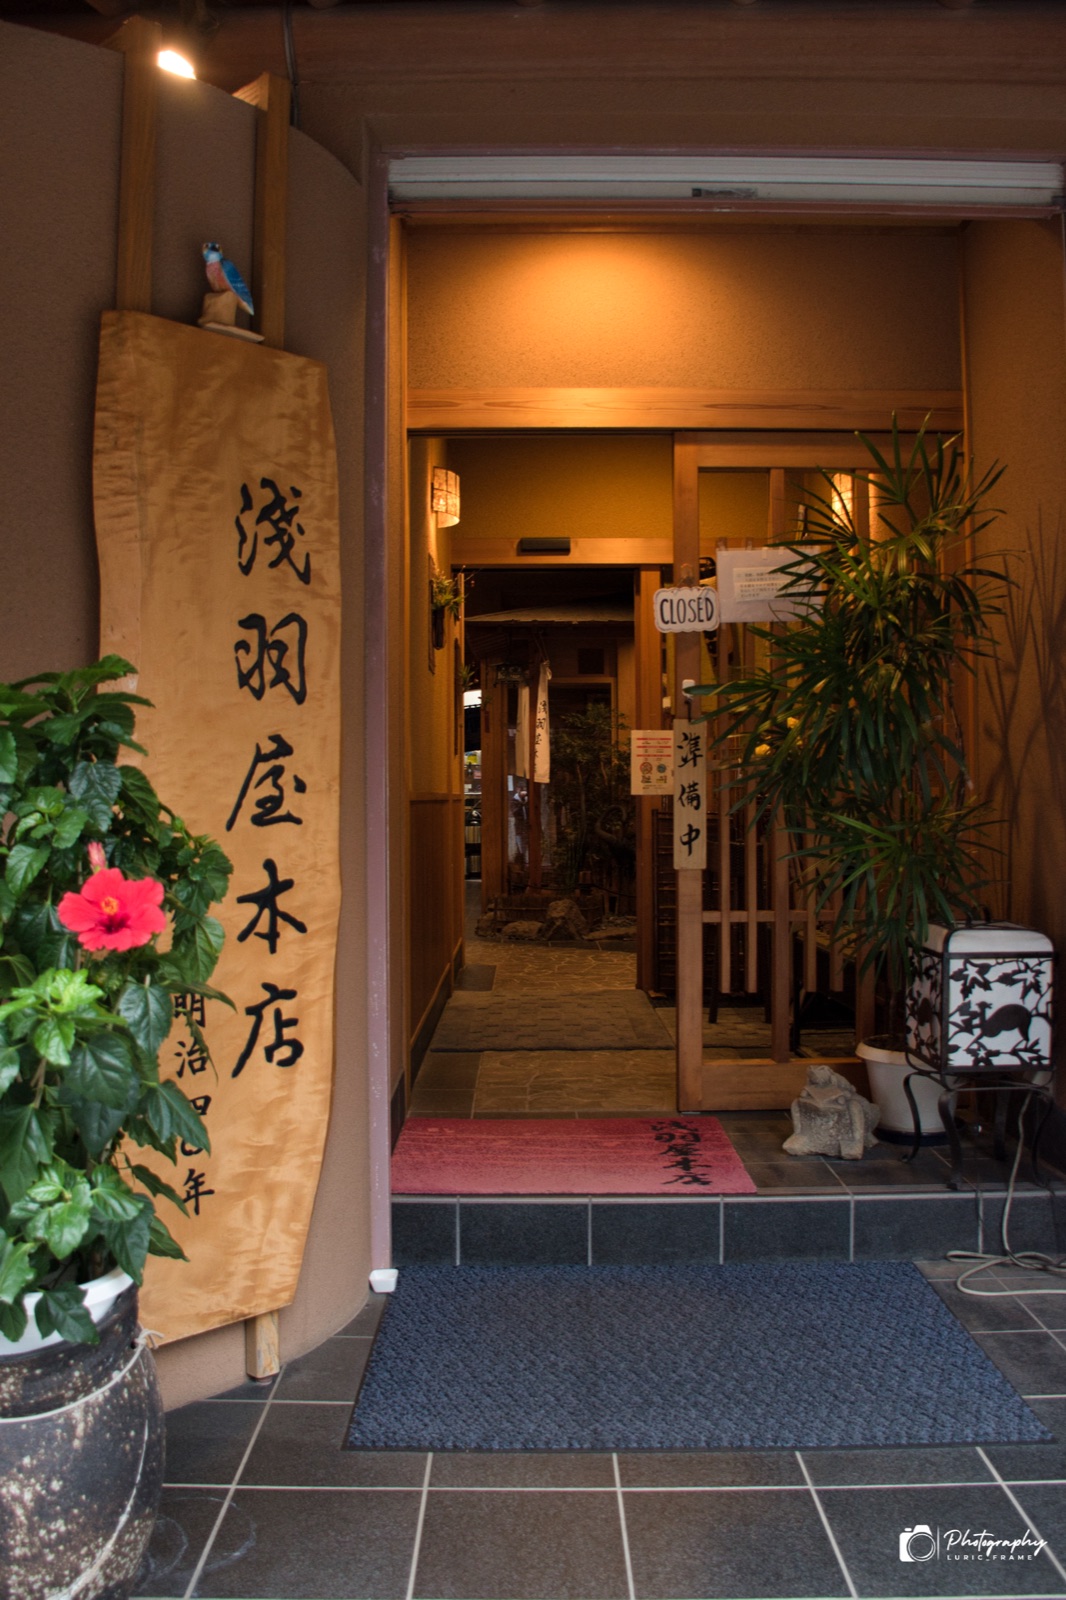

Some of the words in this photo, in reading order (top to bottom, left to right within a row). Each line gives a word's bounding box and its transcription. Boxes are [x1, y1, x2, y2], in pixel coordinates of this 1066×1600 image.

[659, 597, 715, 625] CLOSED
[676, 732, 704, 857] 準備中
